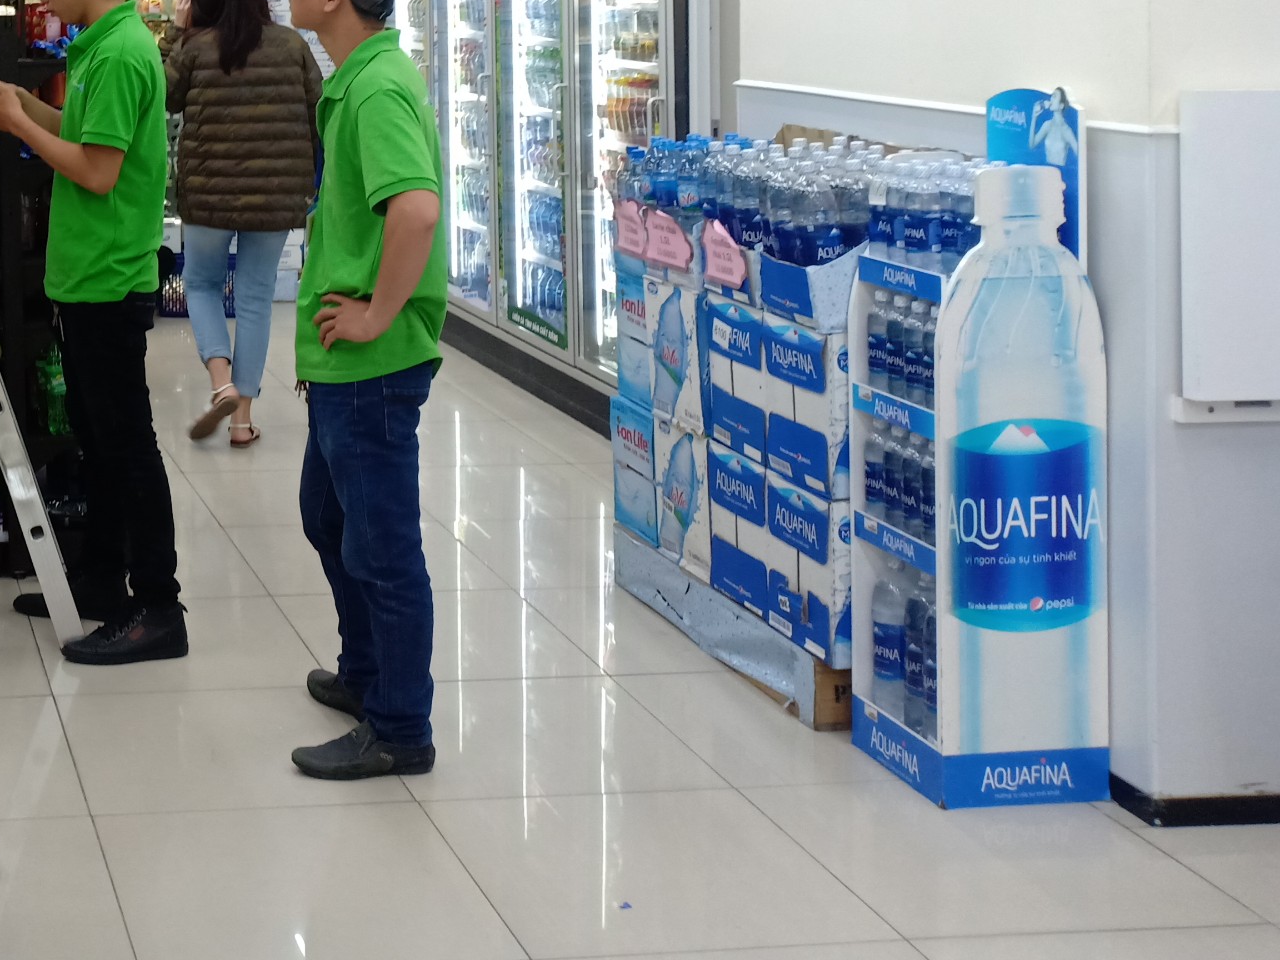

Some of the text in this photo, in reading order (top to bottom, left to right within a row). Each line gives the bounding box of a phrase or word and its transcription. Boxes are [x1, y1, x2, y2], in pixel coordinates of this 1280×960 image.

[989, 106, 1027, 128] AQUAFINA
[883, 266, 917, 290] AQUAFINA
[771, 341, 818, 379] AQUAFINA
[874, 398, 911, 430] AQUAFINA
[716, 469, 757, 510] AQUAFINA
[775, 503, 819, 550] AQUAFINA
[948, 488, 1104, 551] AQUAFINA
[882, 530, 916, 561] AQUAFINA
[974, 555, 996, 567] ngon
[998, 553, 1015, 564] của
[1019, 554, 1030, 565] sự
[1033, 551, 1052, 563] tinh
[1054, 550, 1077, 561] khiết
[1045, 596, 1074, 611] pepsi
[870, 726, 920, 782] AQUAFINA
[981, 761, 1074, 793] AQUAFINA
